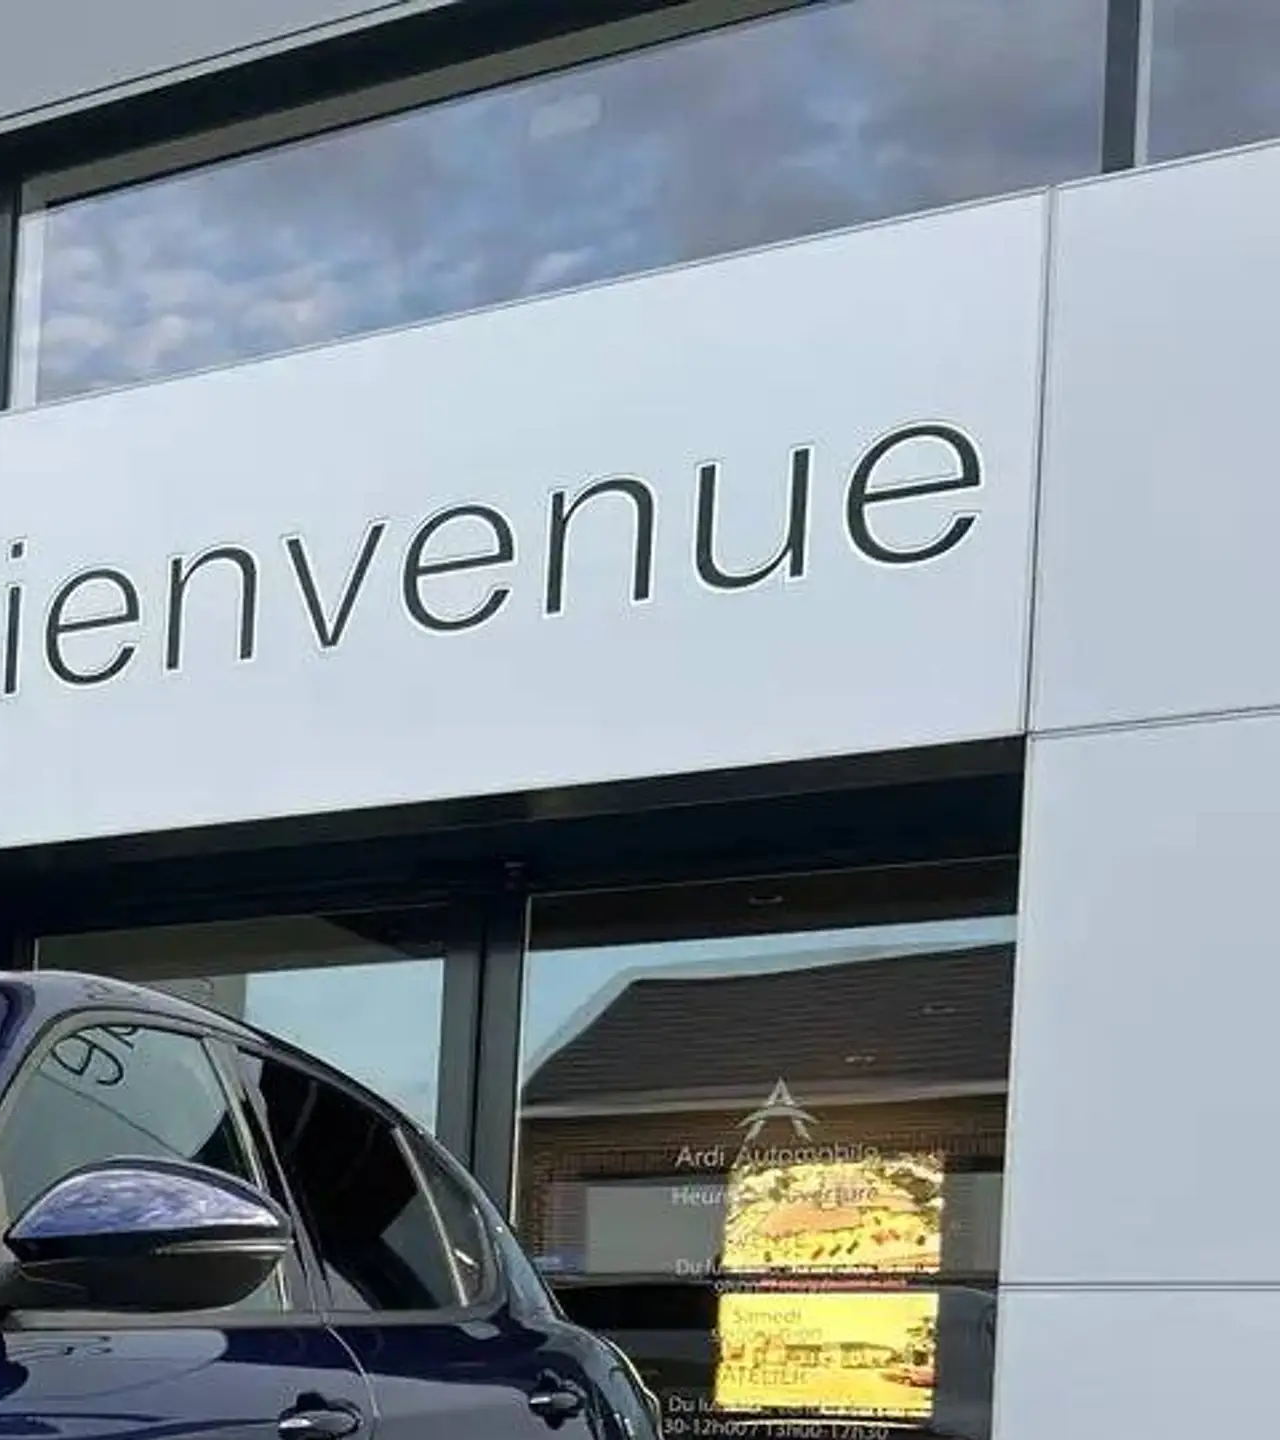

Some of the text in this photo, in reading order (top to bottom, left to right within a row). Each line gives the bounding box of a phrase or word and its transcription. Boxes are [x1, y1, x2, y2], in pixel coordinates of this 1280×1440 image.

[673, 1143, 879, 1168] Ardi Automobile
[731, 1308, 802, 1325] Samedi
